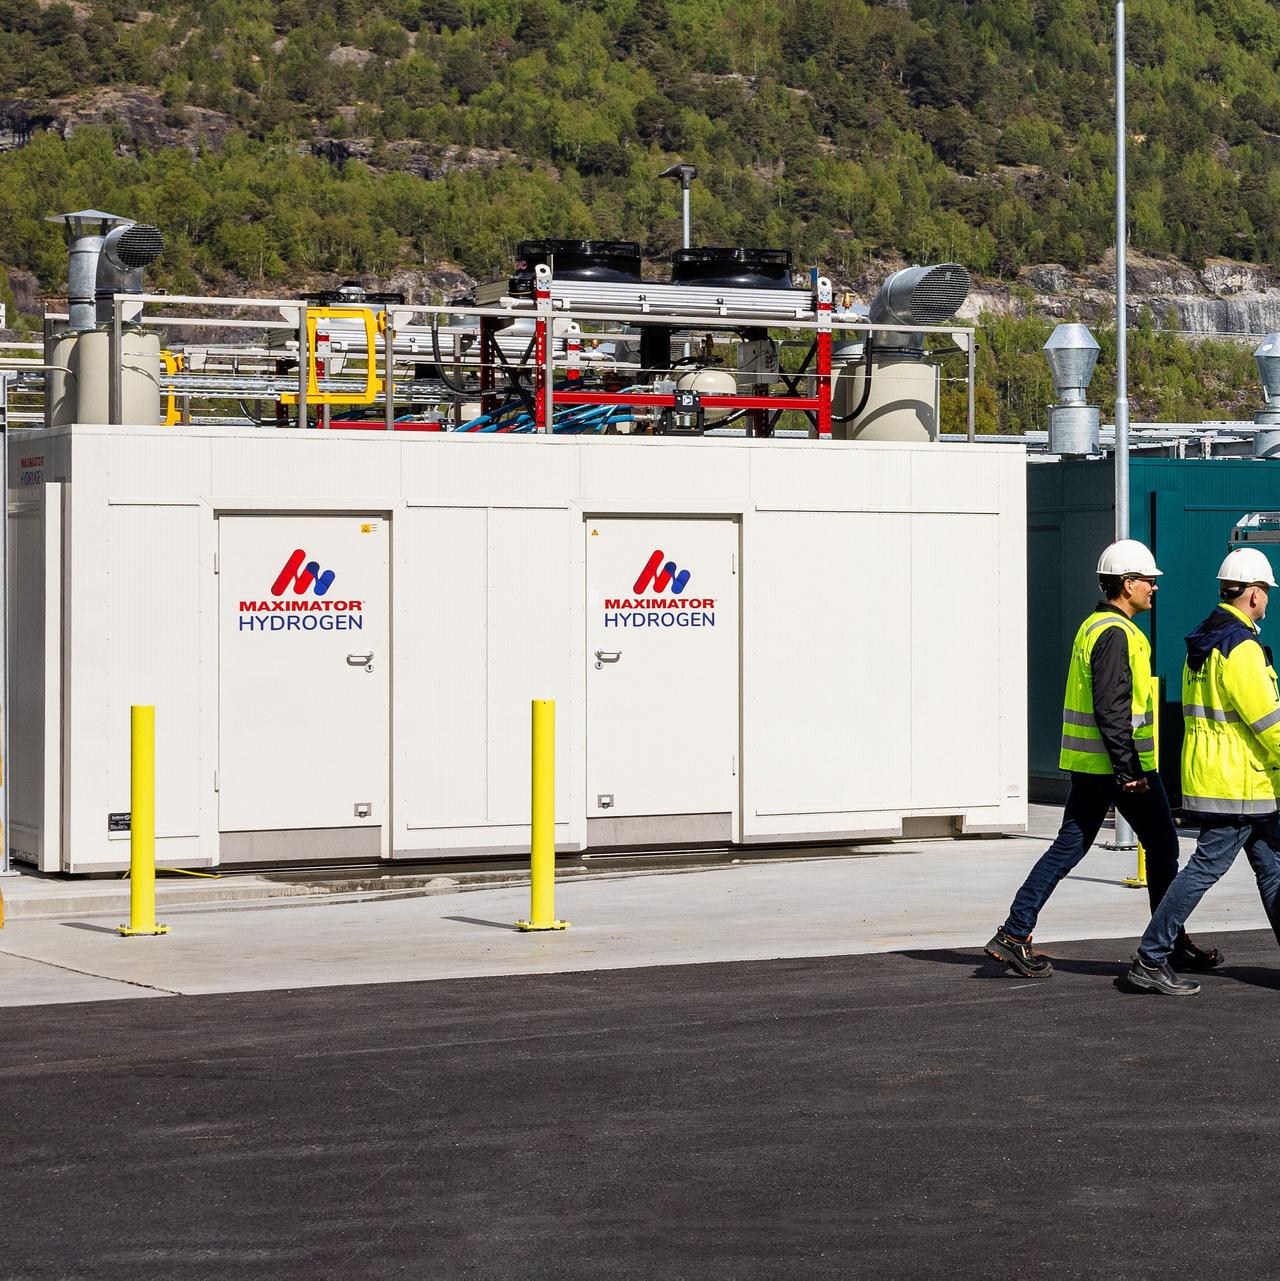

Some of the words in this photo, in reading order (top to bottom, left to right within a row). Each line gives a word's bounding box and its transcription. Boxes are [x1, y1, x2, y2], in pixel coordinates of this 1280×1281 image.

[239, 600, 362, 612] MAXIMATOR
[604, 598, 715, 609] MAXIMATOR
[239, 615, 363, 631] HYDROGEN
[604, 612, 715, 627] HYDROGEN
